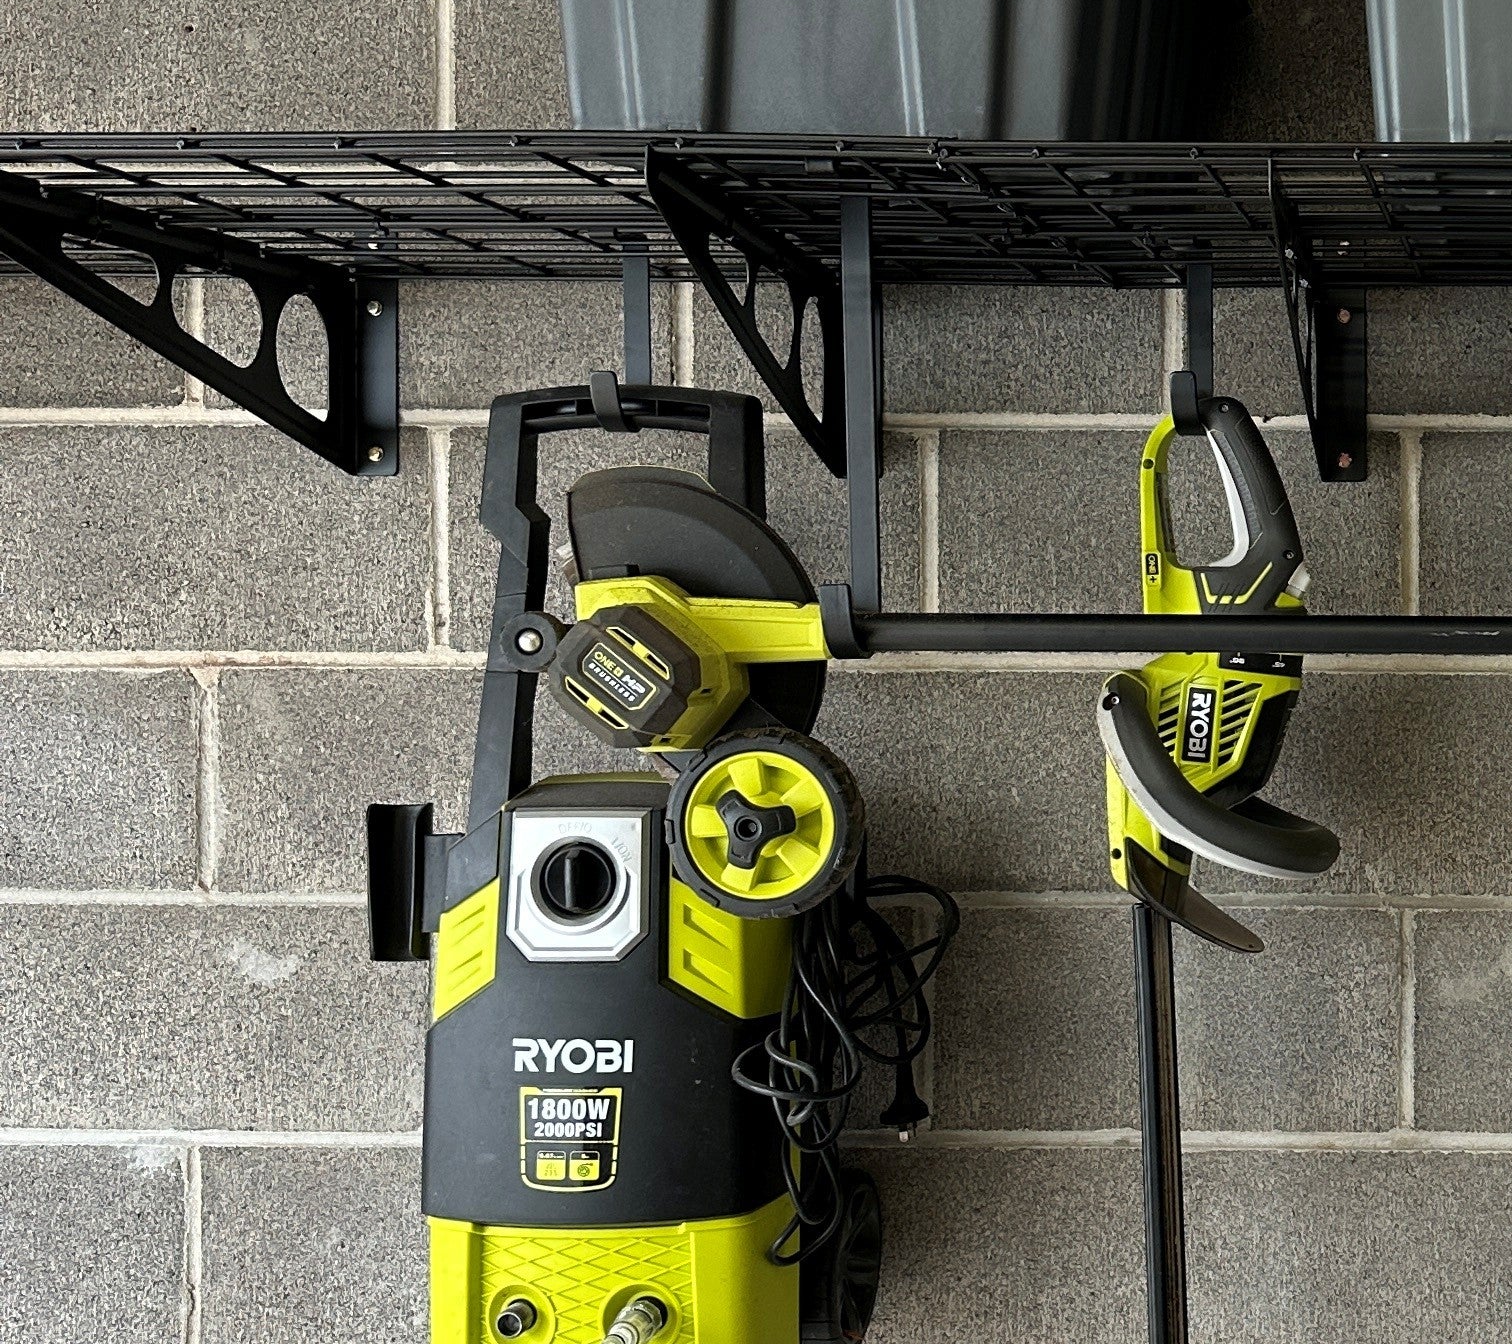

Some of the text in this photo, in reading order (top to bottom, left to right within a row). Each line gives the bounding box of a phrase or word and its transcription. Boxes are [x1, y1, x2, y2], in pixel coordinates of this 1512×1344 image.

[1187, 692, 1212, 758] RYOBI
[512, 1038, 634, 1074] RYOBI
[527, 1098, 610, 1120] 1800W
[534, 1122, 602, 1138] 2000PSI
